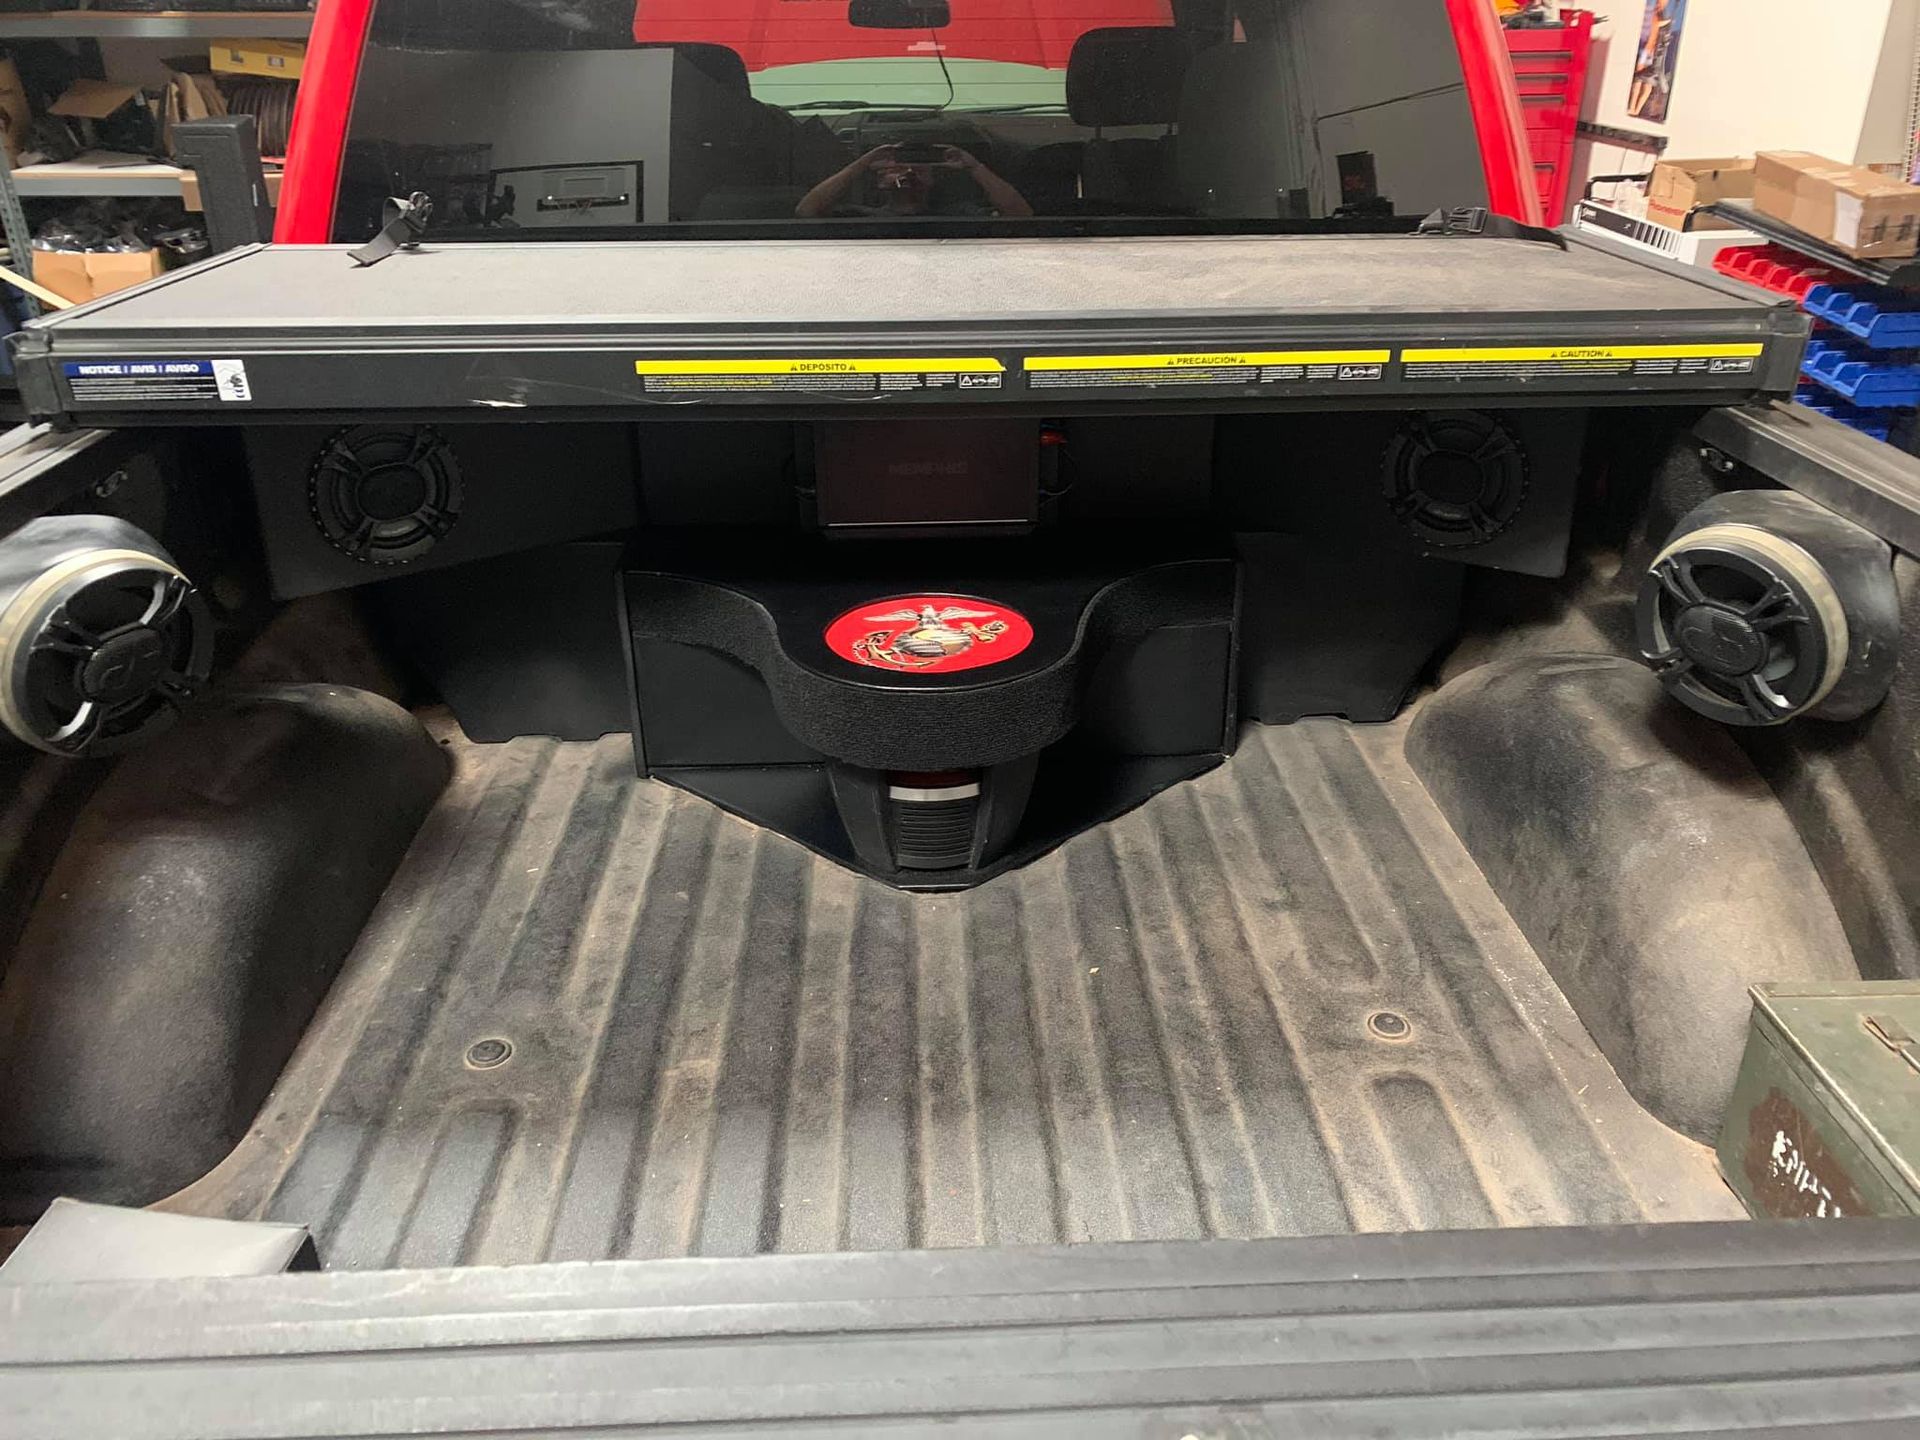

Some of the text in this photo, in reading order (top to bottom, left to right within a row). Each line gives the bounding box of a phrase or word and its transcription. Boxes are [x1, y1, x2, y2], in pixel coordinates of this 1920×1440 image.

[1560, 350, 1604, 358] CAUTION
[78, 365, 122, 375] NOTICE
[130, 365, 157, 374] AVIS
[165, 363, 200, 373] AVISO
